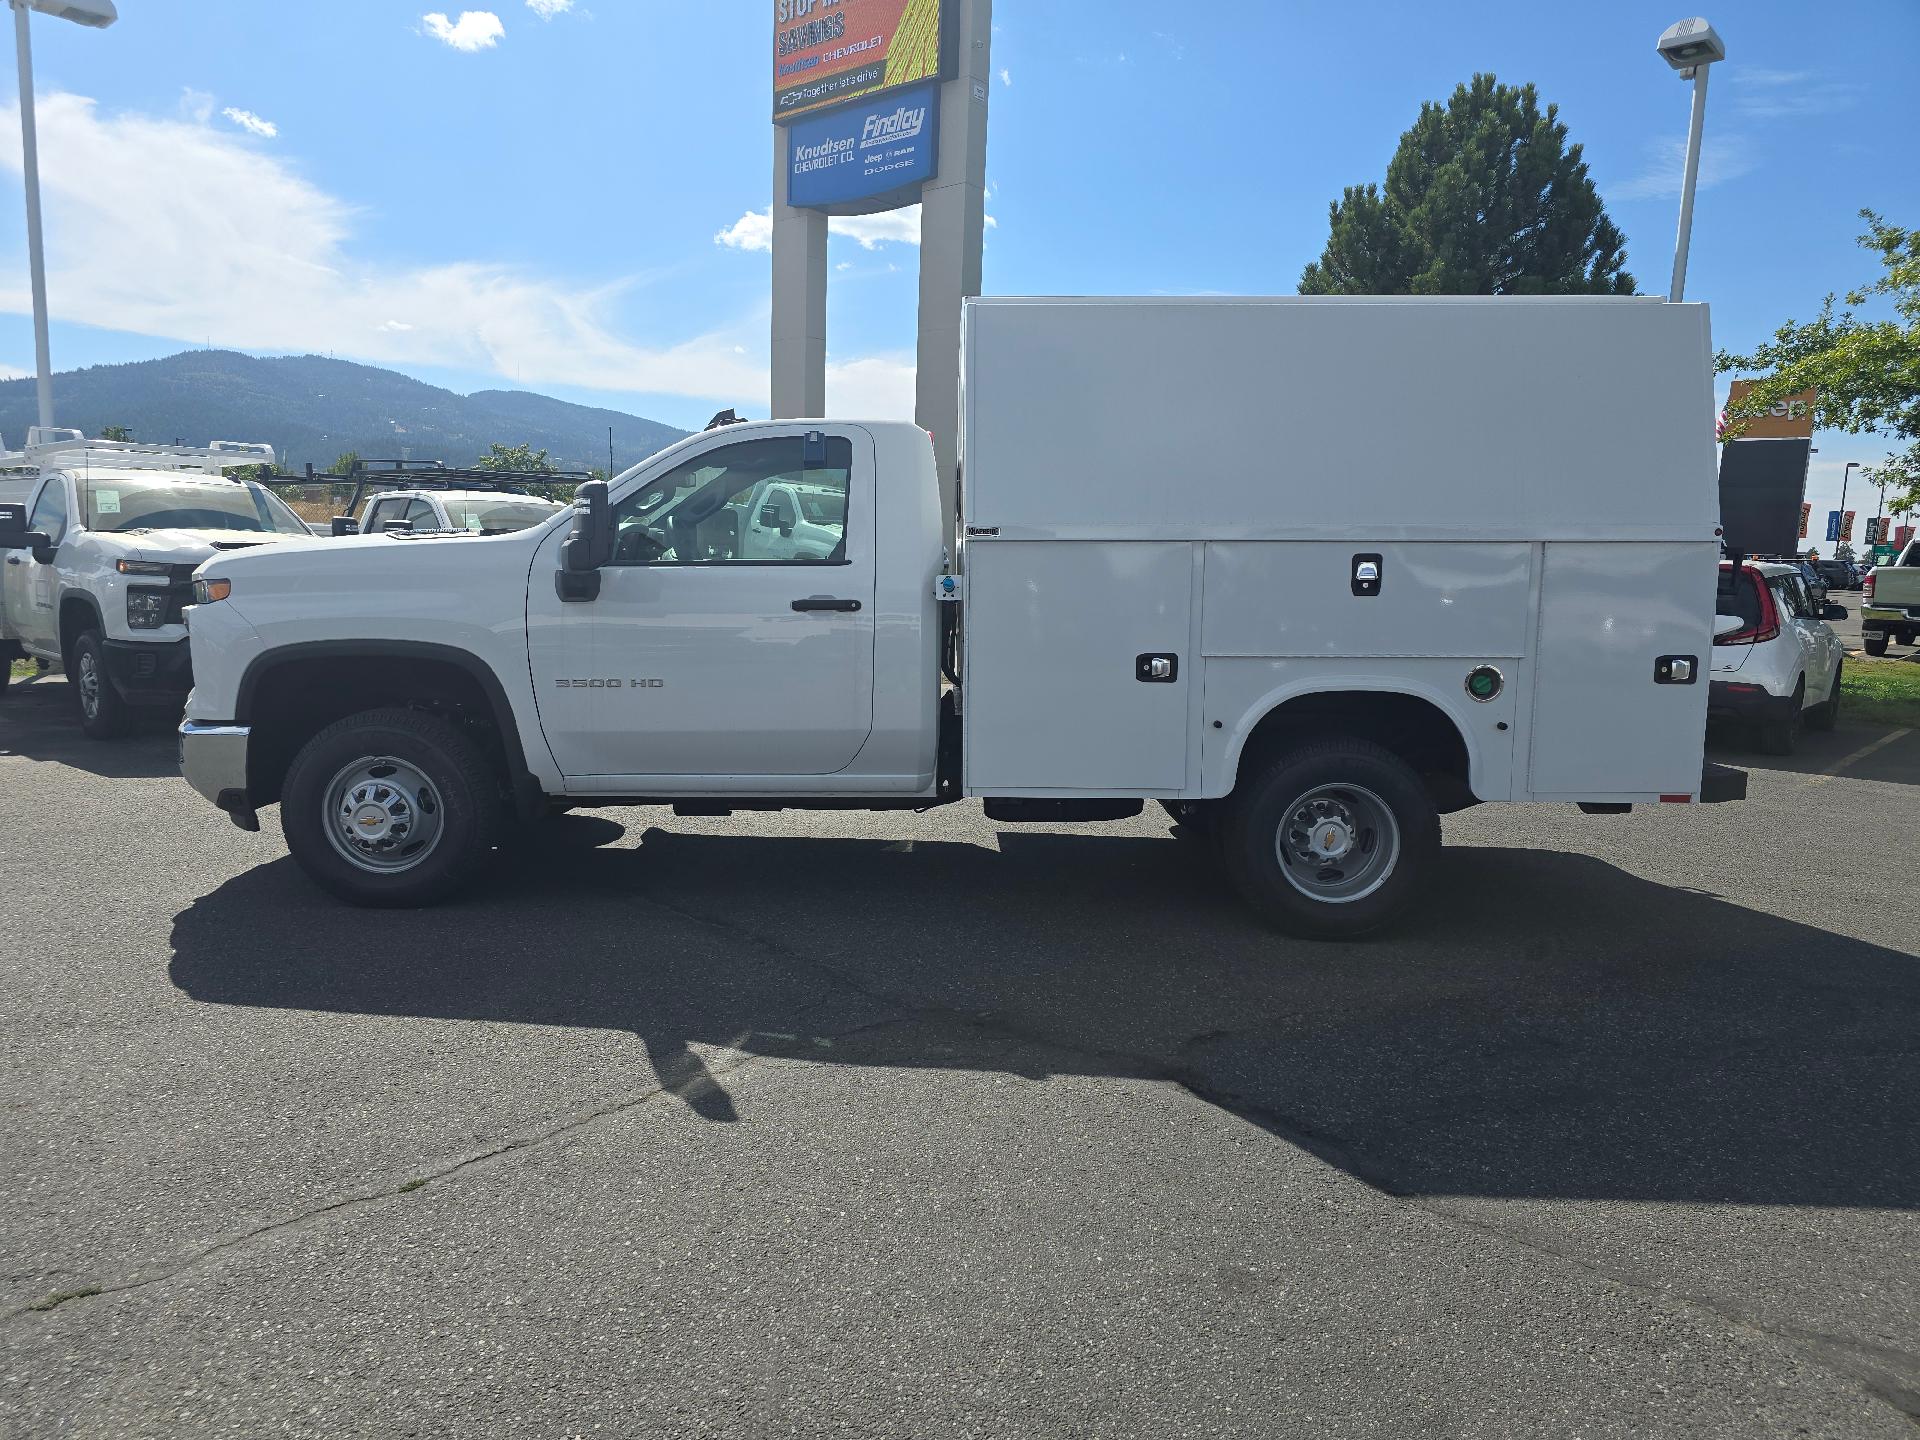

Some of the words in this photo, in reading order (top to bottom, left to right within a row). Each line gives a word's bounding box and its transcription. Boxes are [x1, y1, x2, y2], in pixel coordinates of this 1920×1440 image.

[778, 11, 844, 56] SAVINGS
[823, 35, 883, 62] CHEVROLET
[803, 81, 838, 99] Together
[856, 69, 877, 83] drive
[861, 107, 925, 140] Findlay
[795, 138, 855, 162] Knudtsen
[864, 154, 883, 164] Jeep
[893, 146, 915, 156] RAM
[795, 154, 838, 174] CHEVROLET
[864, 159, 915, 175] DODGE
[555, 679, 621, 688] 3500
[631, 679, 664, 688] HD
